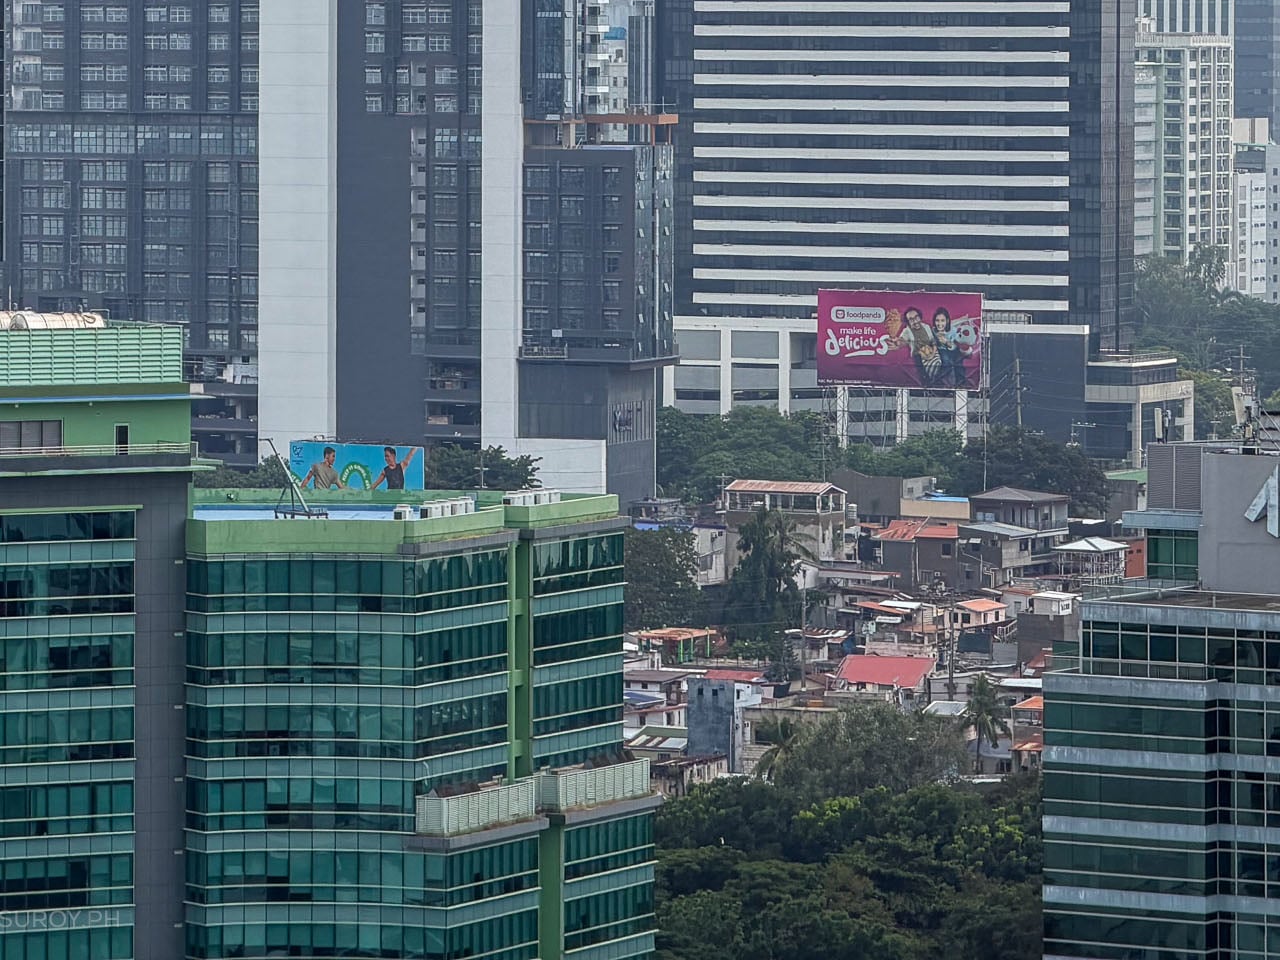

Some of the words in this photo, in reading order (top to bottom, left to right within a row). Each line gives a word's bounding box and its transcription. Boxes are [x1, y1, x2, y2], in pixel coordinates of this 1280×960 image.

[846, 311, 881, 319] foodpanda
[839, 326, 863, 335] make
[863, 326, 877, 335] life
[825, 328, 890, 356] delicious
